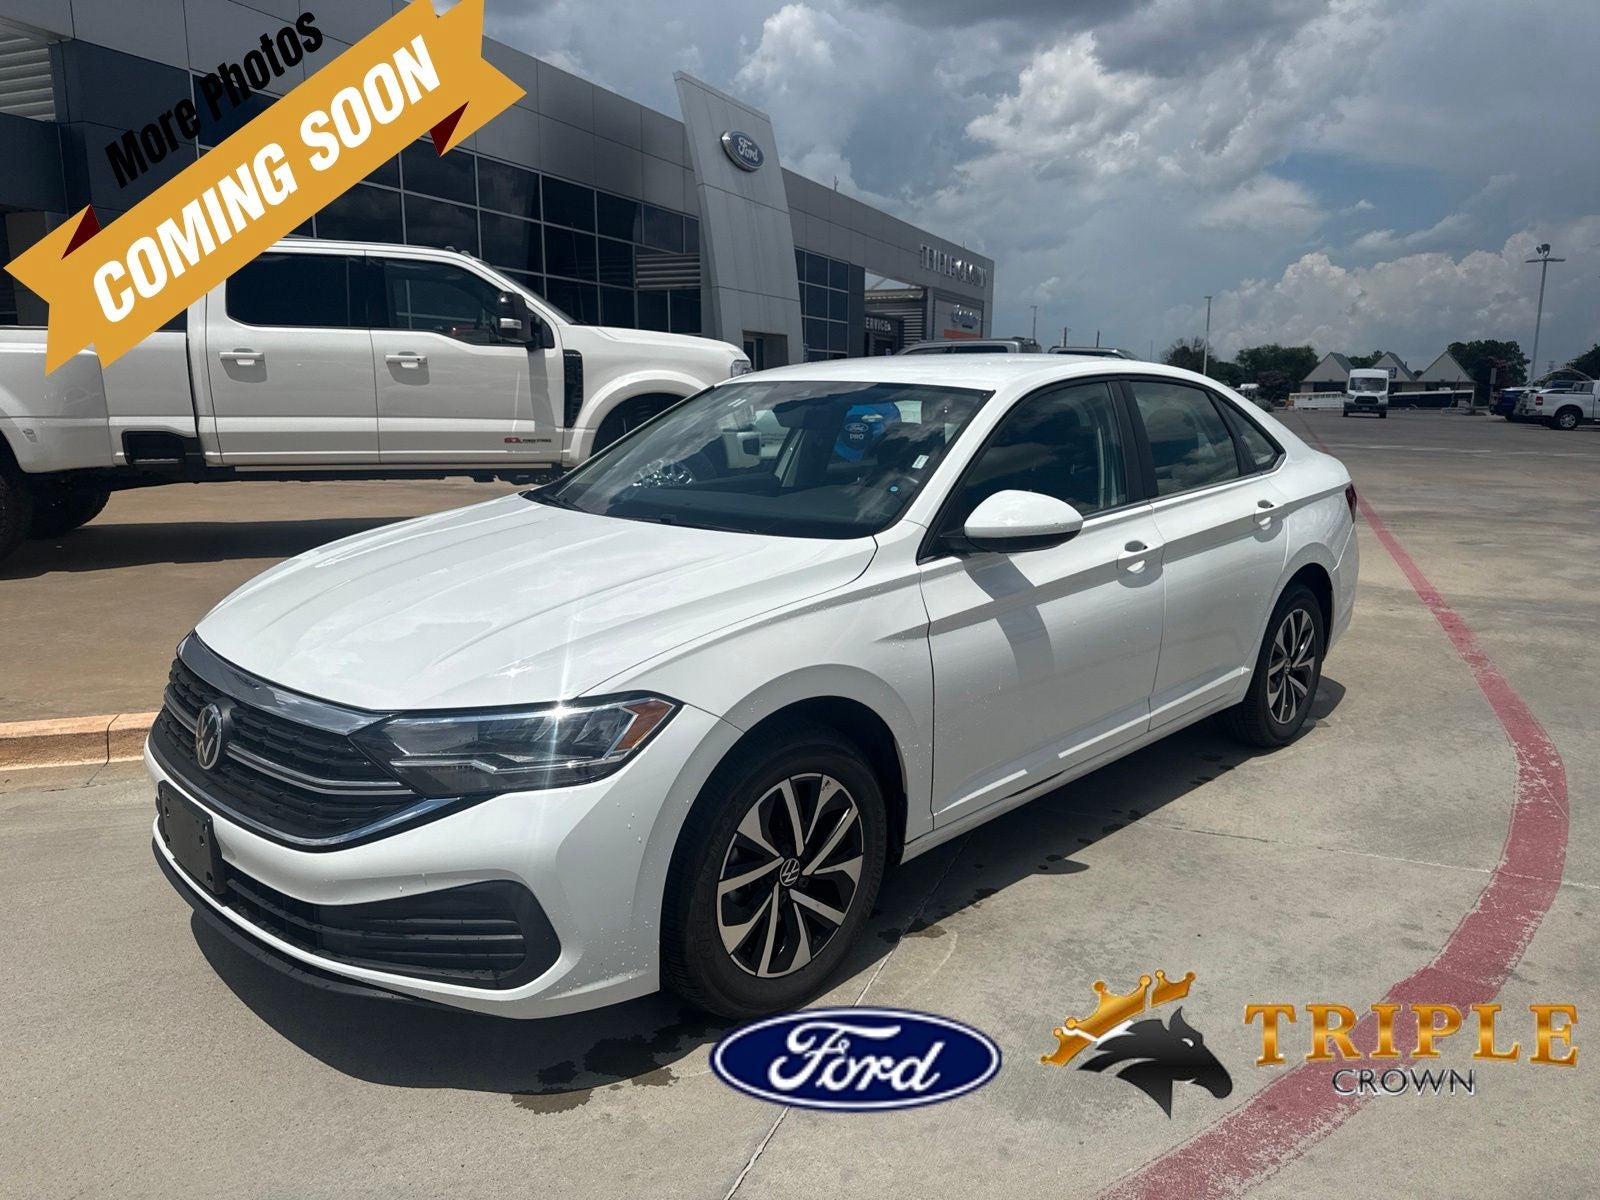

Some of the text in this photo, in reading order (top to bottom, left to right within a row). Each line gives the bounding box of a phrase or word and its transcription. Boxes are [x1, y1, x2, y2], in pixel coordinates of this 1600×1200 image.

[738, 137, 759, 162] Ford
[919, 243, 956, 277] TRIPLE
[865, 316, 891, 331] ERVICE
